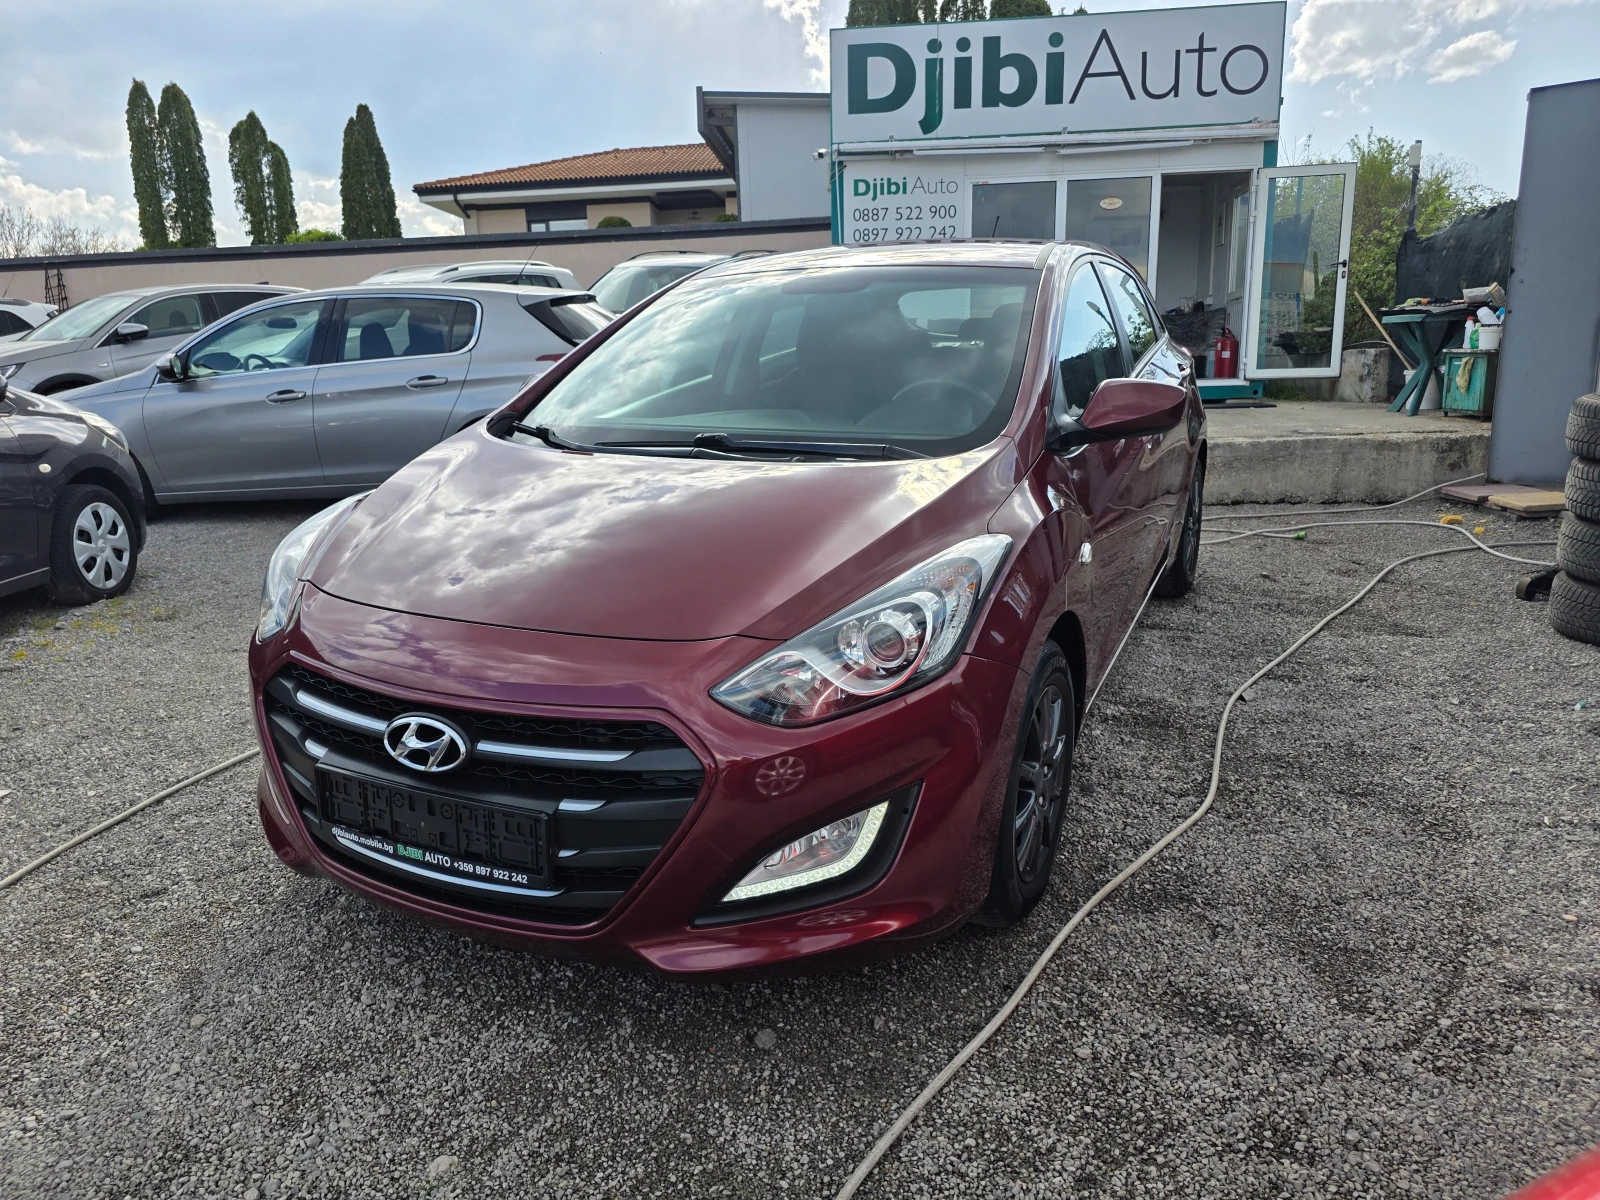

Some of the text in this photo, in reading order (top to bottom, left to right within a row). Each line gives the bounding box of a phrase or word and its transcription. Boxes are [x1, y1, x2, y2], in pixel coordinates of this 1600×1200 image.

[853, 176, 959, 202] Djibi Auto
[853, 204, 957, 222] 0887 522 900
[853, 224, 957, 242] 0897 922 242
[397, 844, 424, 861] DJIBI
[424, 851, 451, 867] AUTO
[453, 861, 474, 873] +359
[475, 865, 491, 877] 897
[493, 869, 510, 881] 922
[511, 872, 528, 884] 242
